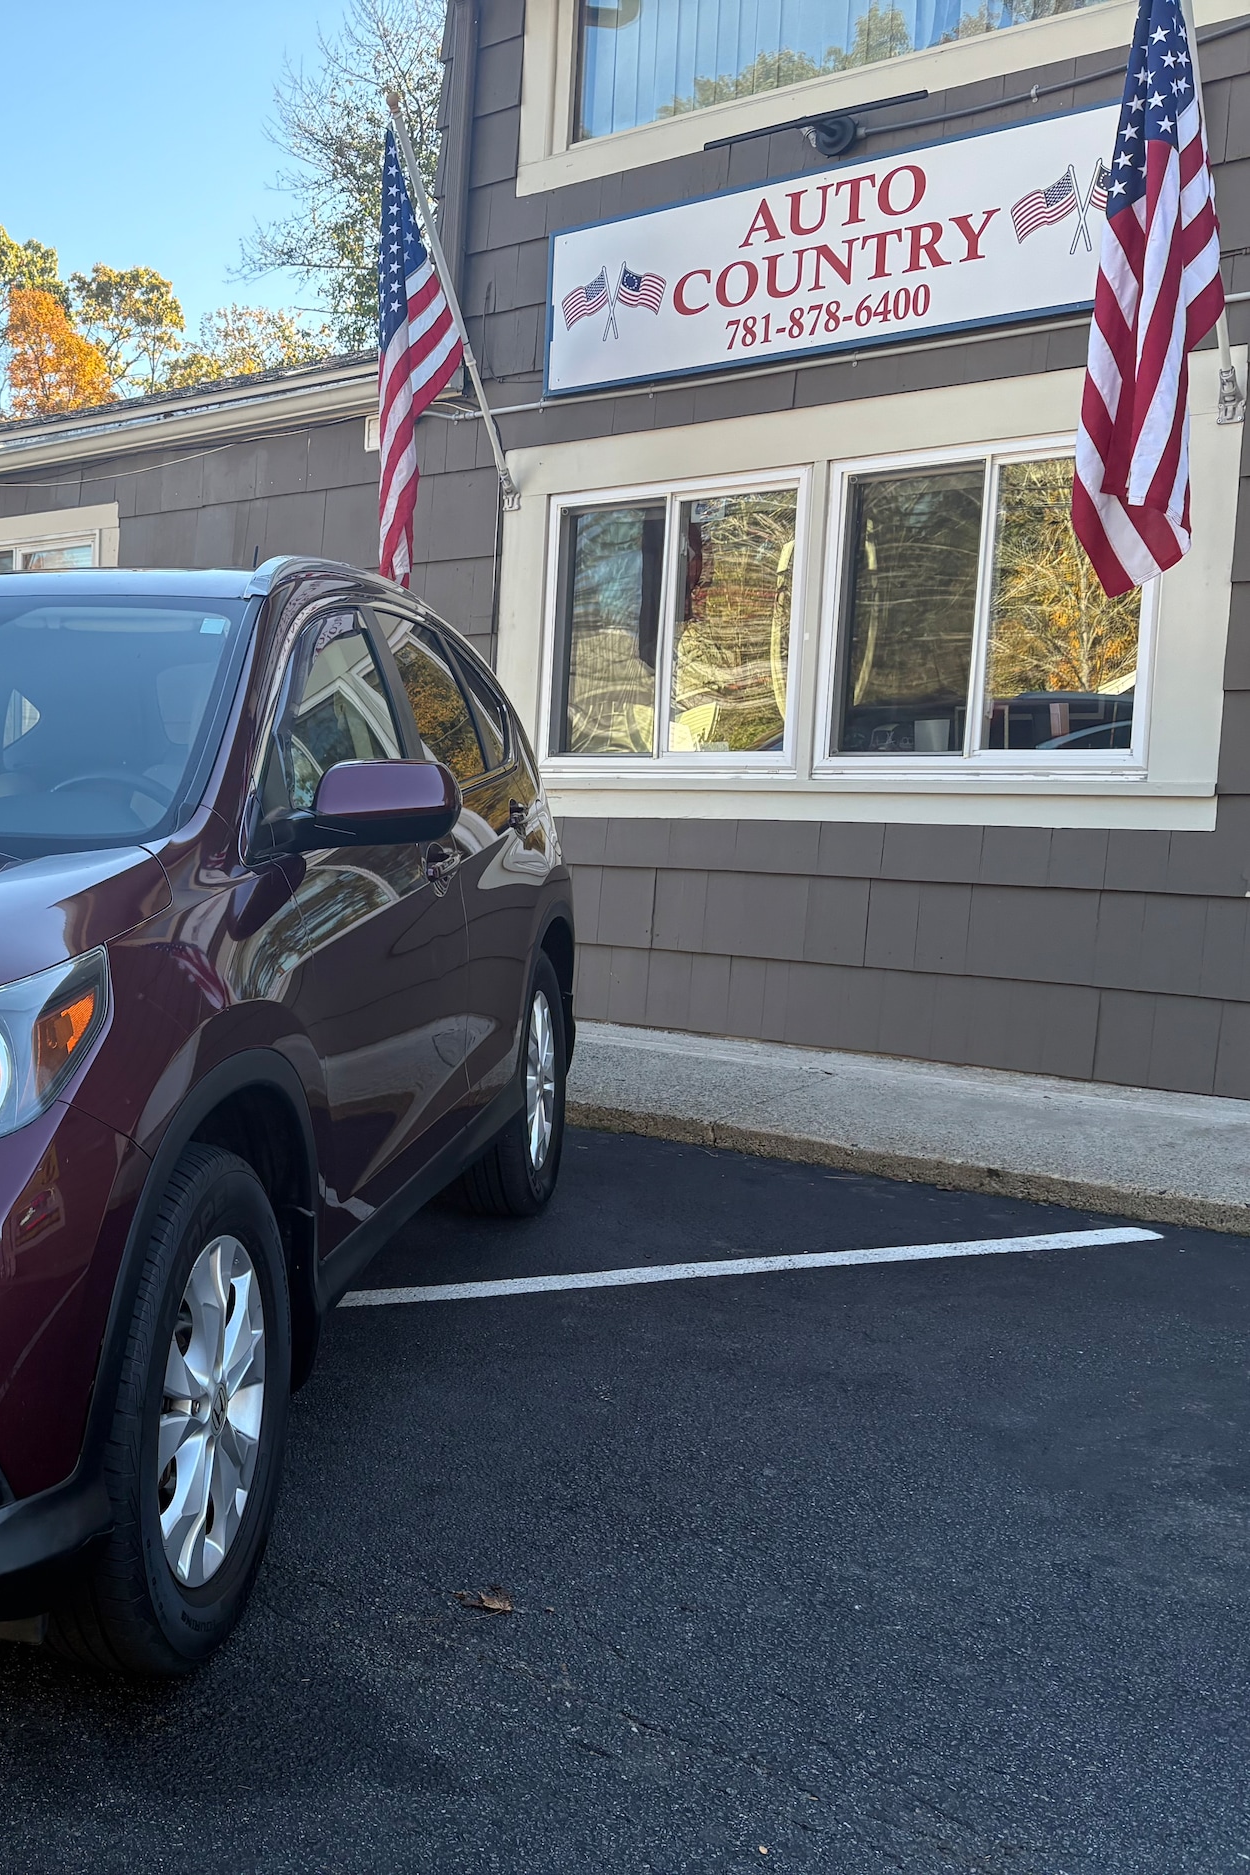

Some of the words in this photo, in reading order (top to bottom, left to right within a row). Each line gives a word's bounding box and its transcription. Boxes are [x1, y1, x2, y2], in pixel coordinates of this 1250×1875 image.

[738, 164, 927, 248] AUTO
[672, 208, 1001, 316] COUNTRY
[725, 283, 932, 350] 781-878-6400
